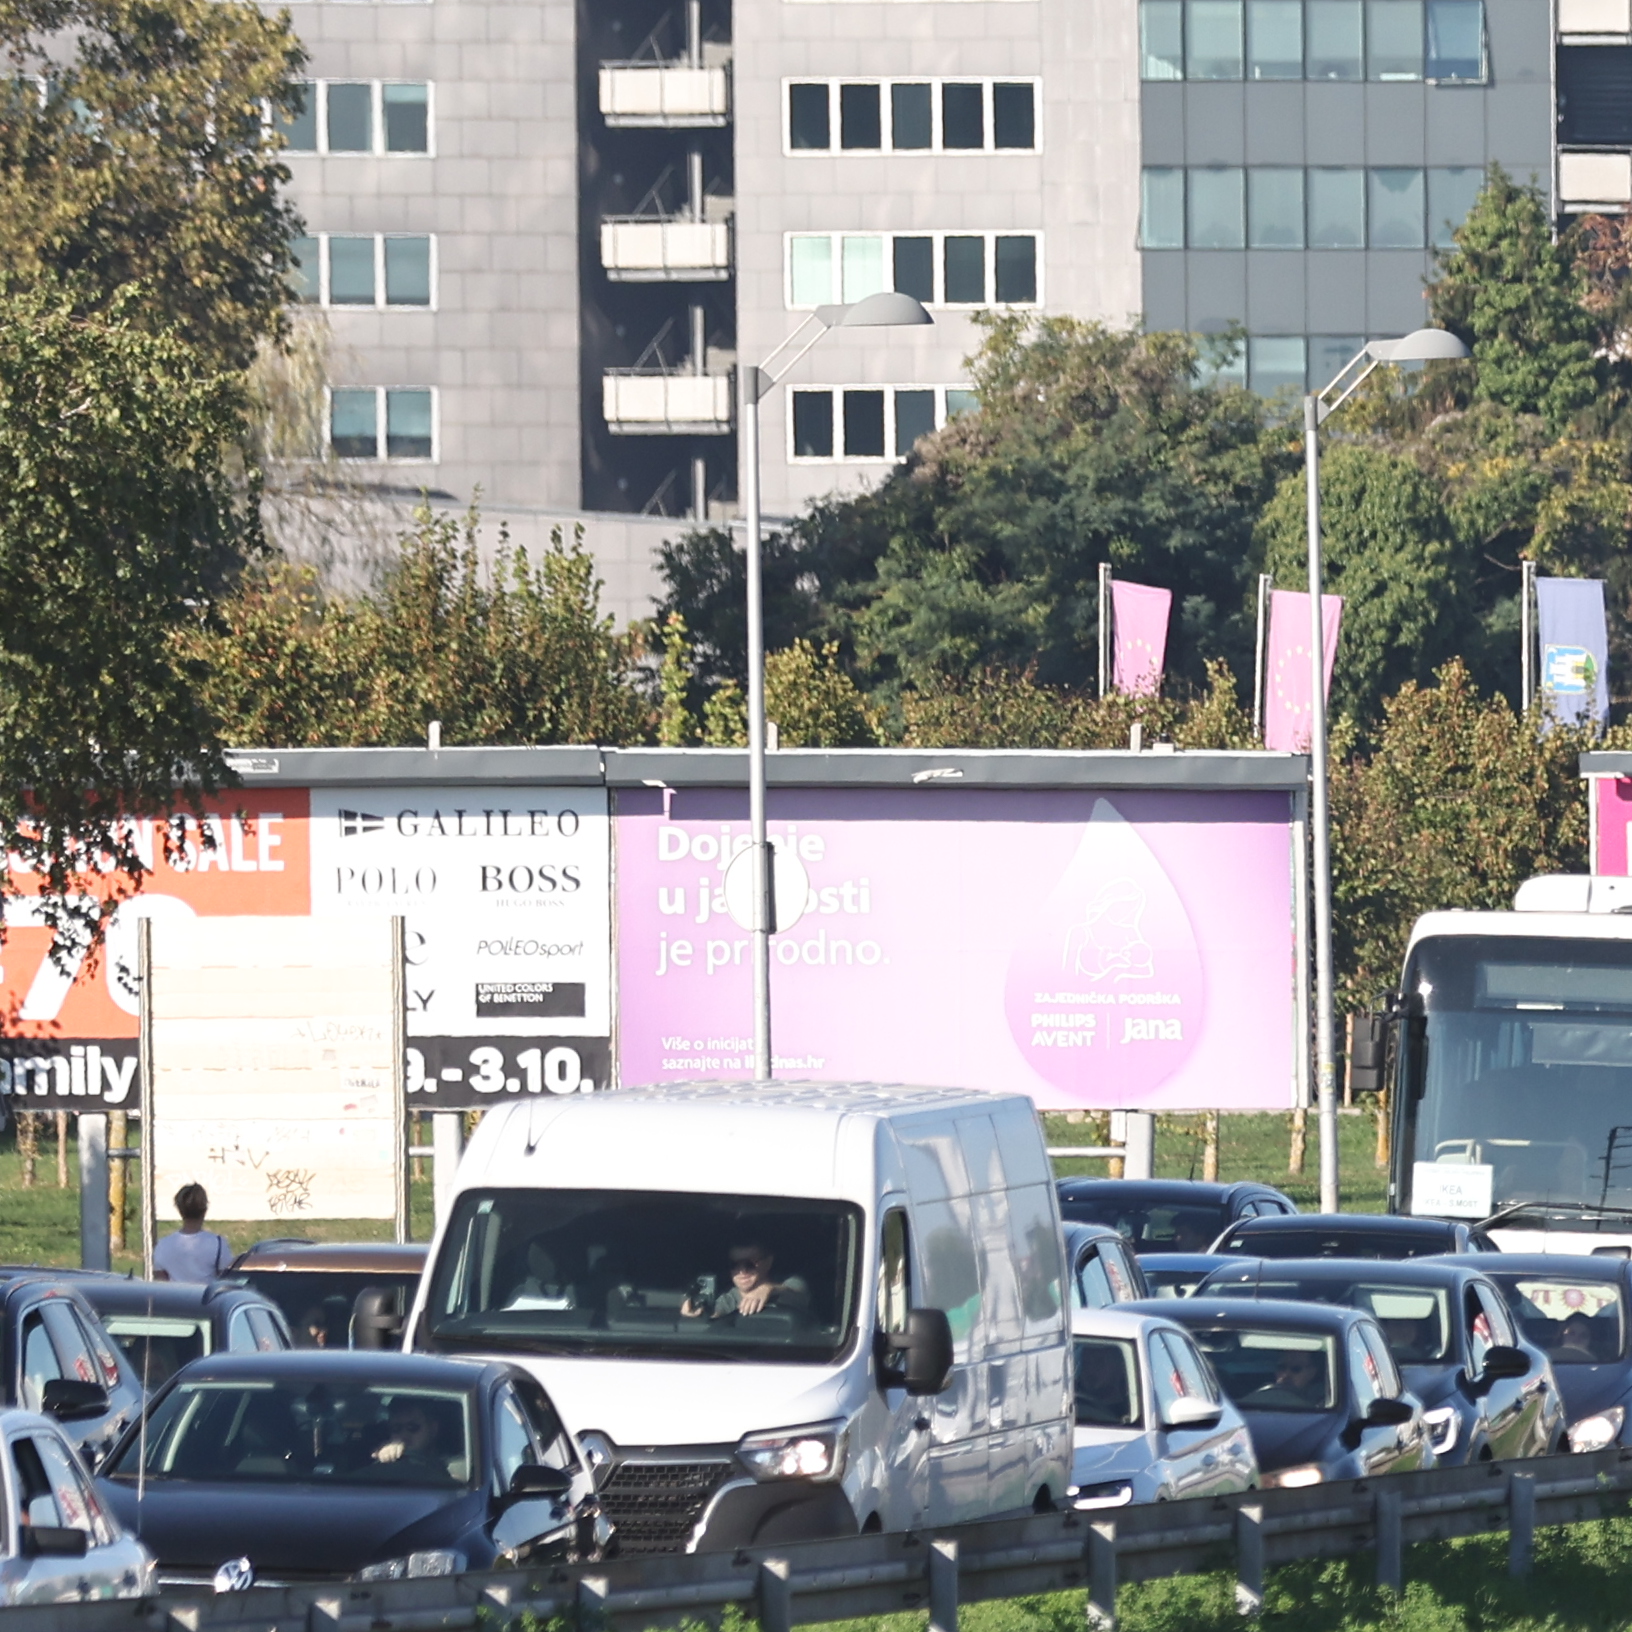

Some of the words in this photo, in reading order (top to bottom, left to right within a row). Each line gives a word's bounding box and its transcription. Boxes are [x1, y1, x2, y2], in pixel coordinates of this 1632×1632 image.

[396, 808, 580, 838] GALILEO
[336, 865, 438, 895] POLO
[478, 864, 582, 894] BOSS
[658, 888, 685, 915] u
[655, 931, 693, 976] je
[478, 984, 514, 994] UNITED
[515, 984, 553, 994] COLORS
[478, 994, 490, 1003] OF
[492, 993, 544, 1004] BENETTON
[1034, 991, 1116, 1005] ZAJEDNIČKA
[1118, 991, 1182, 1005] PODRŠKA
[1031, 1013, 1097, 1028] PHILIPS
[661, 1036, 690, 1051] Više
[694, 1041, 705, 1051] o
[707, 1036, 755, 1054] inicijat
[1031, 1030, 1096, 1047] AVENT
[662, 1057, 720, 1072] saznajte
[723, 1060, 741, 1070] na
[0, 1046, 138, 1104] mily
[1440, 1184, 1463, 1196] IKEA
